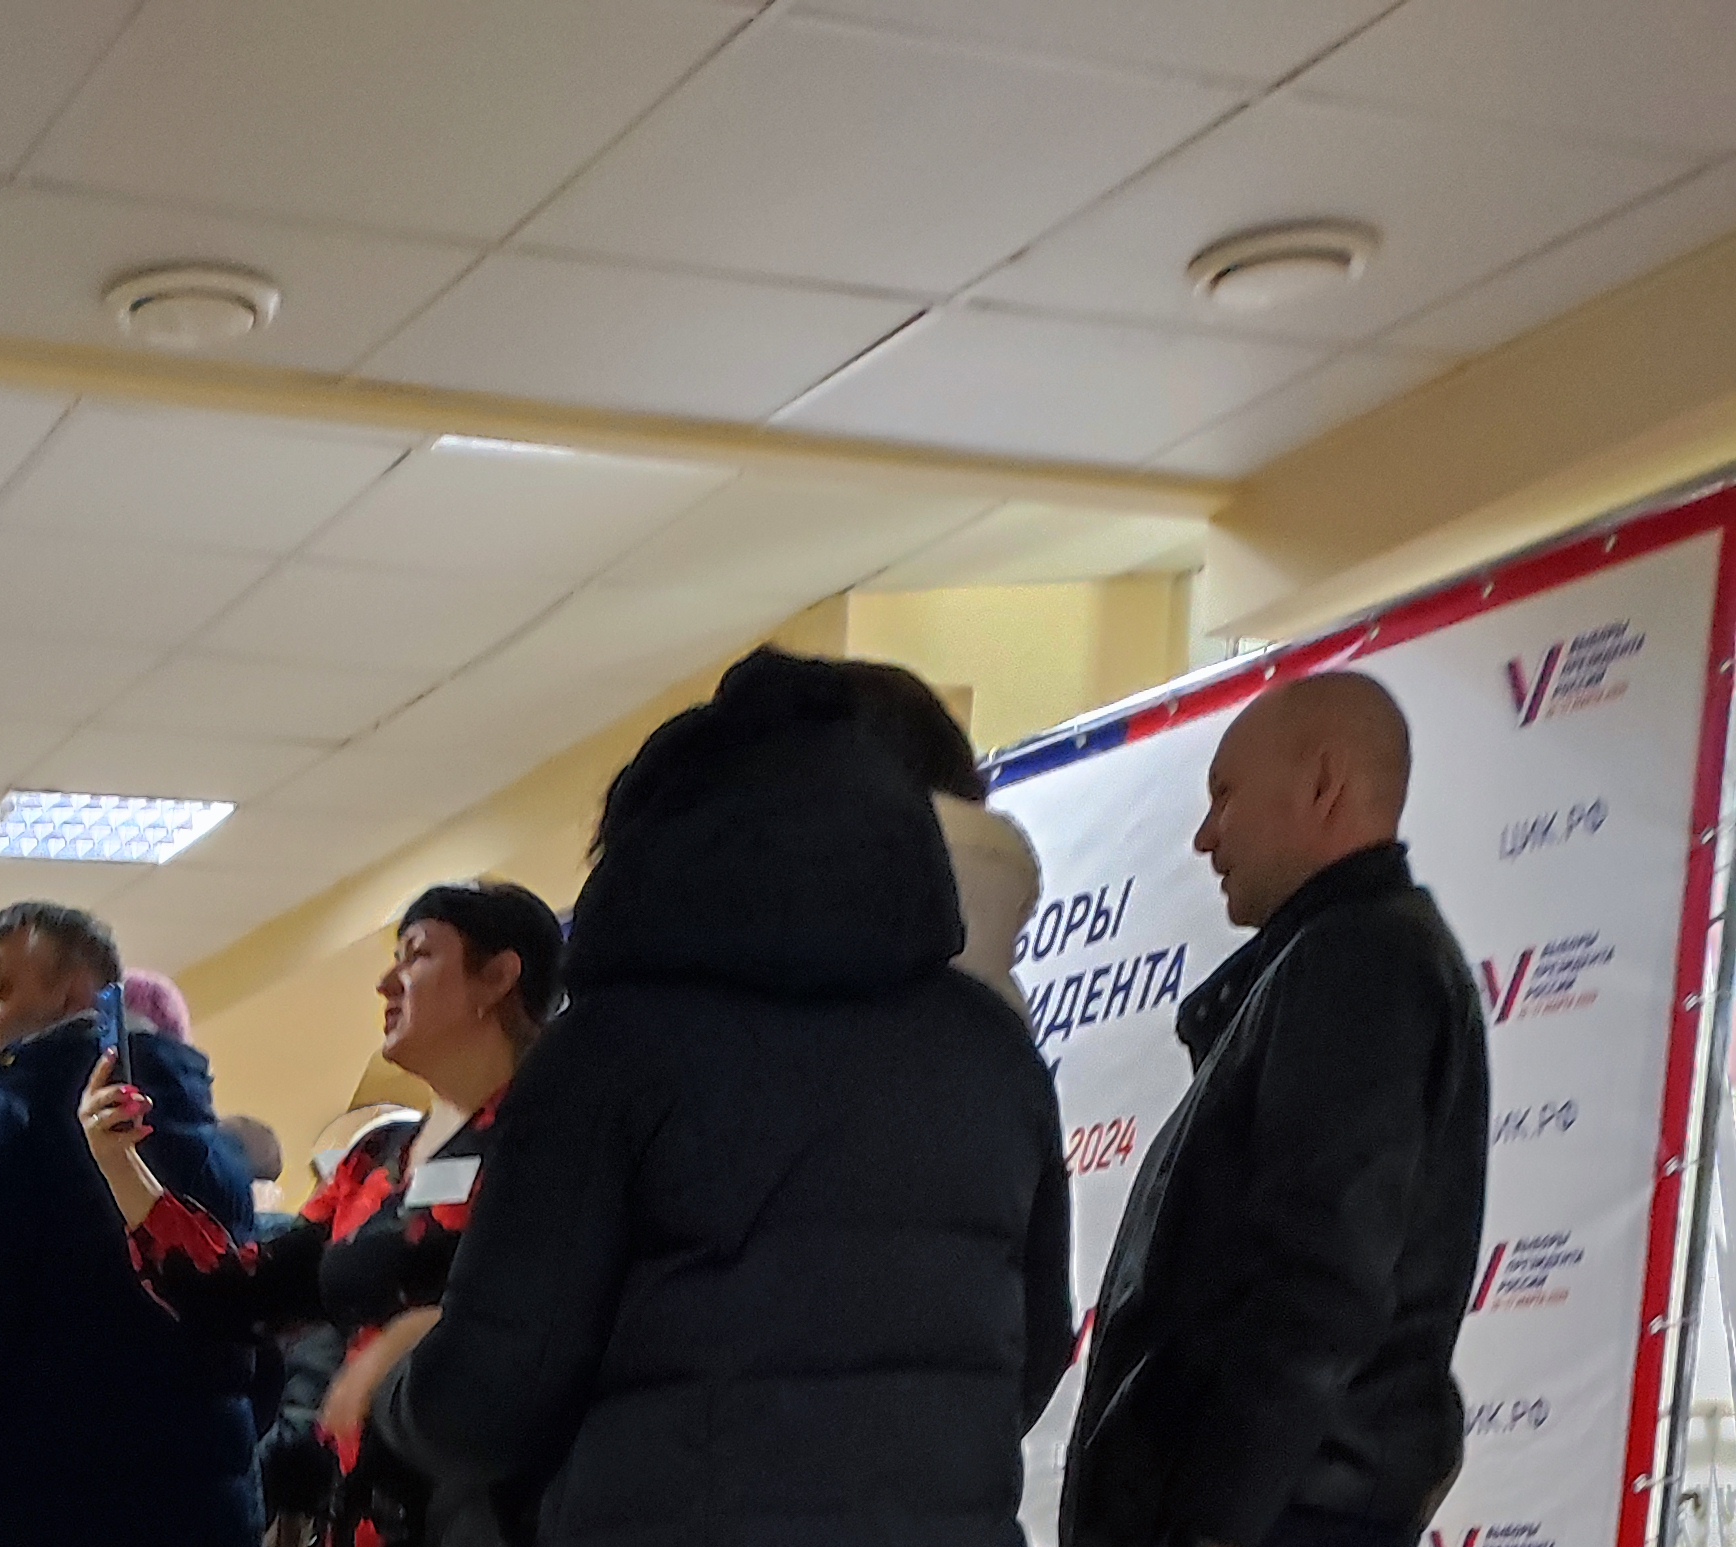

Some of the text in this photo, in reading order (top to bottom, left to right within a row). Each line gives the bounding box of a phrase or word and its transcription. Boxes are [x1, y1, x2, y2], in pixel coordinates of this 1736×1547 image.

[1066, 1115, 1136, 1177] 2024
[1491, 1098, 1579, 1146] ИК.РФ
[1464, 1396, 1551, 1436] ИК.РФ
